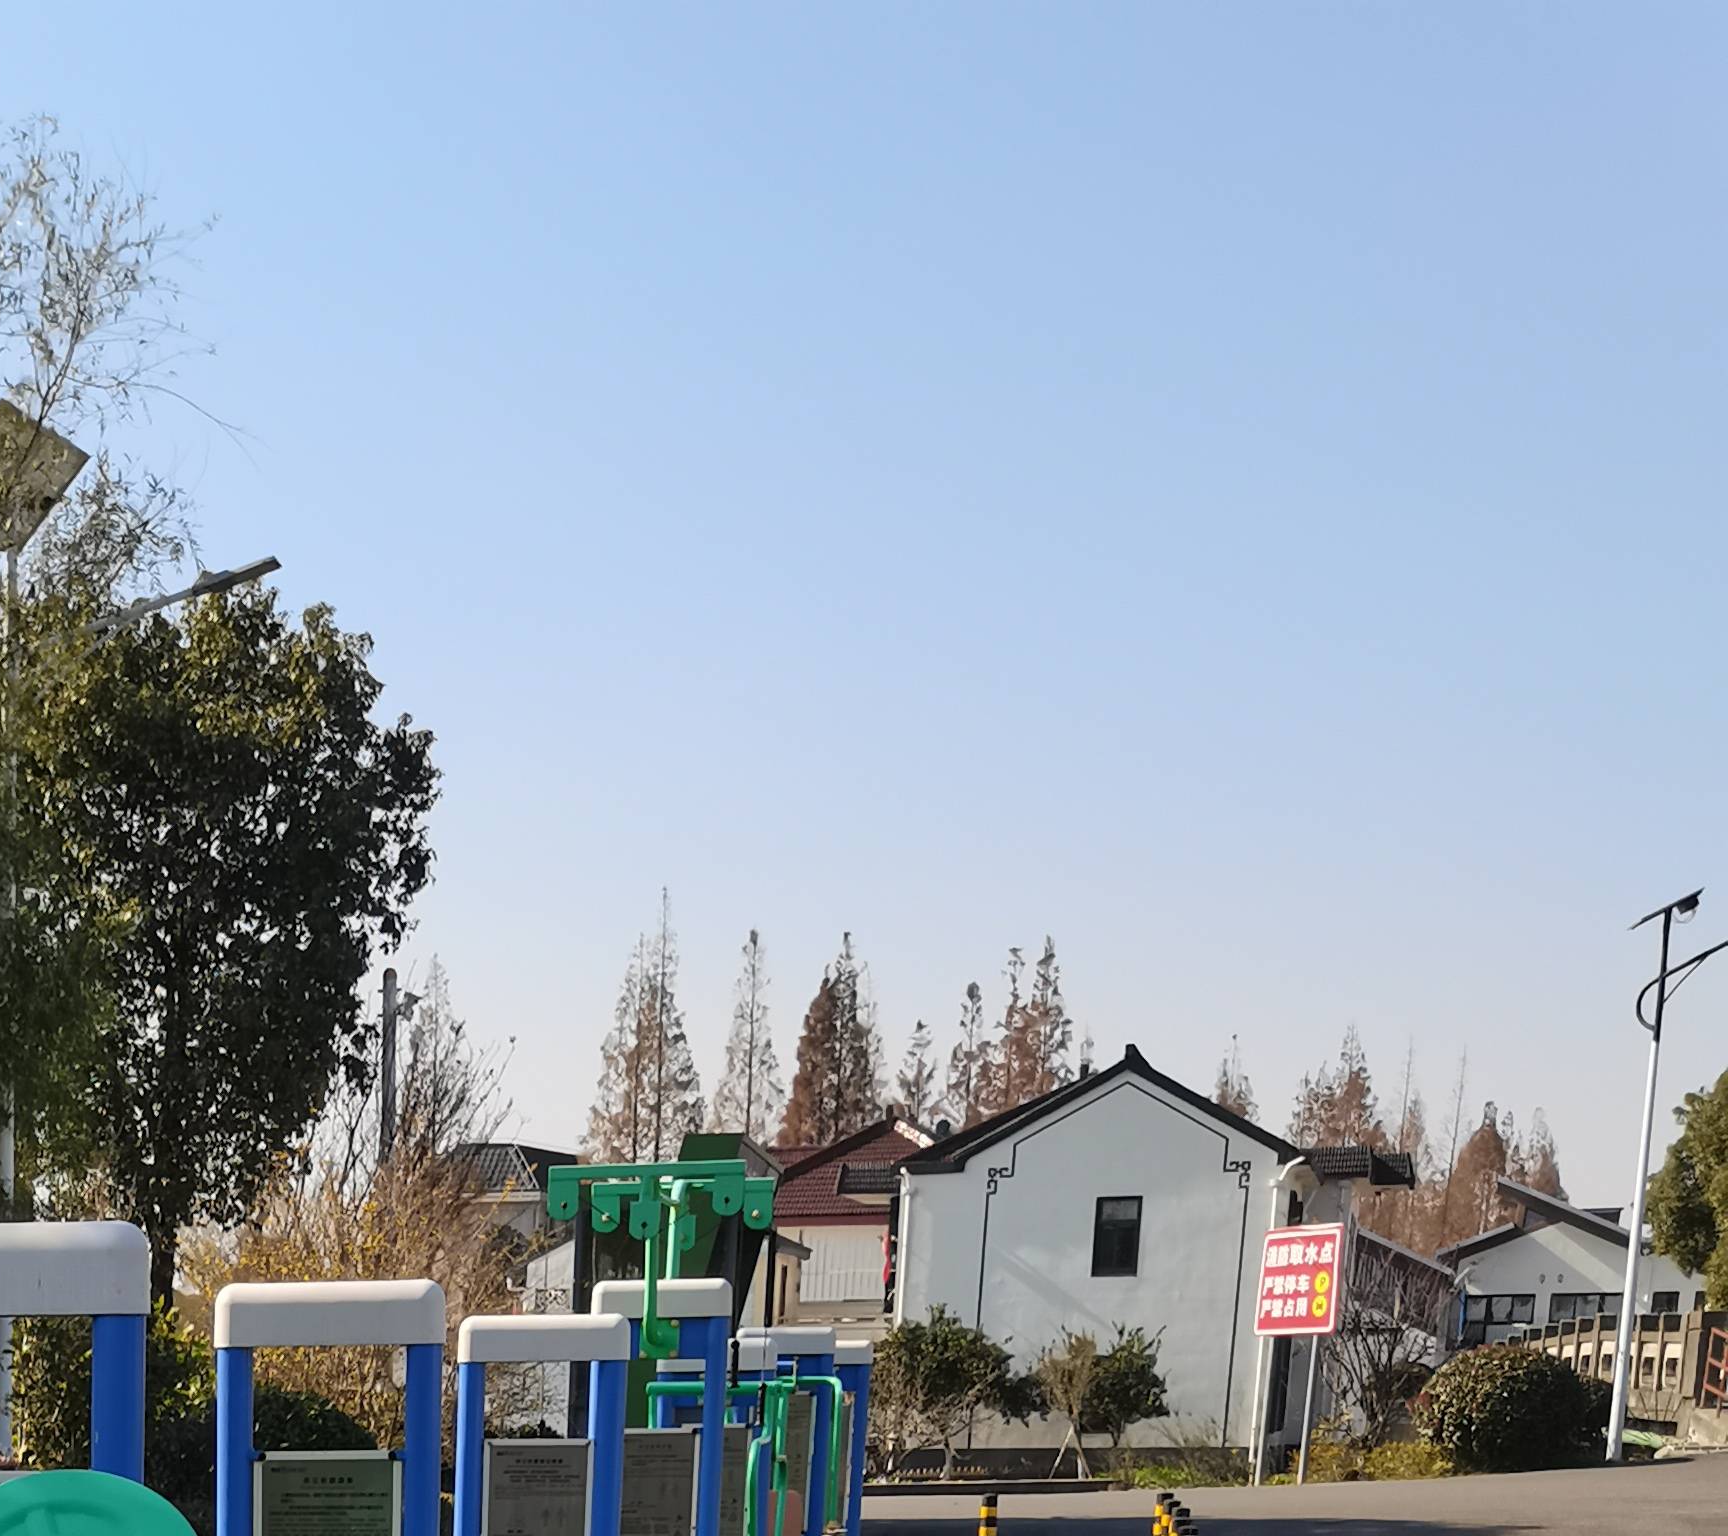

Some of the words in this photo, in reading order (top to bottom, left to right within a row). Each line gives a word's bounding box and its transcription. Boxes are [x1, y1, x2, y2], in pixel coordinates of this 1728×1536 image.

[1265, 1241, 1334, 1267] 消防取水点
[1262, 1274, 1310, 1297] 严禁停车
[1260, 1297, 1308, 1319] 严禁占用
